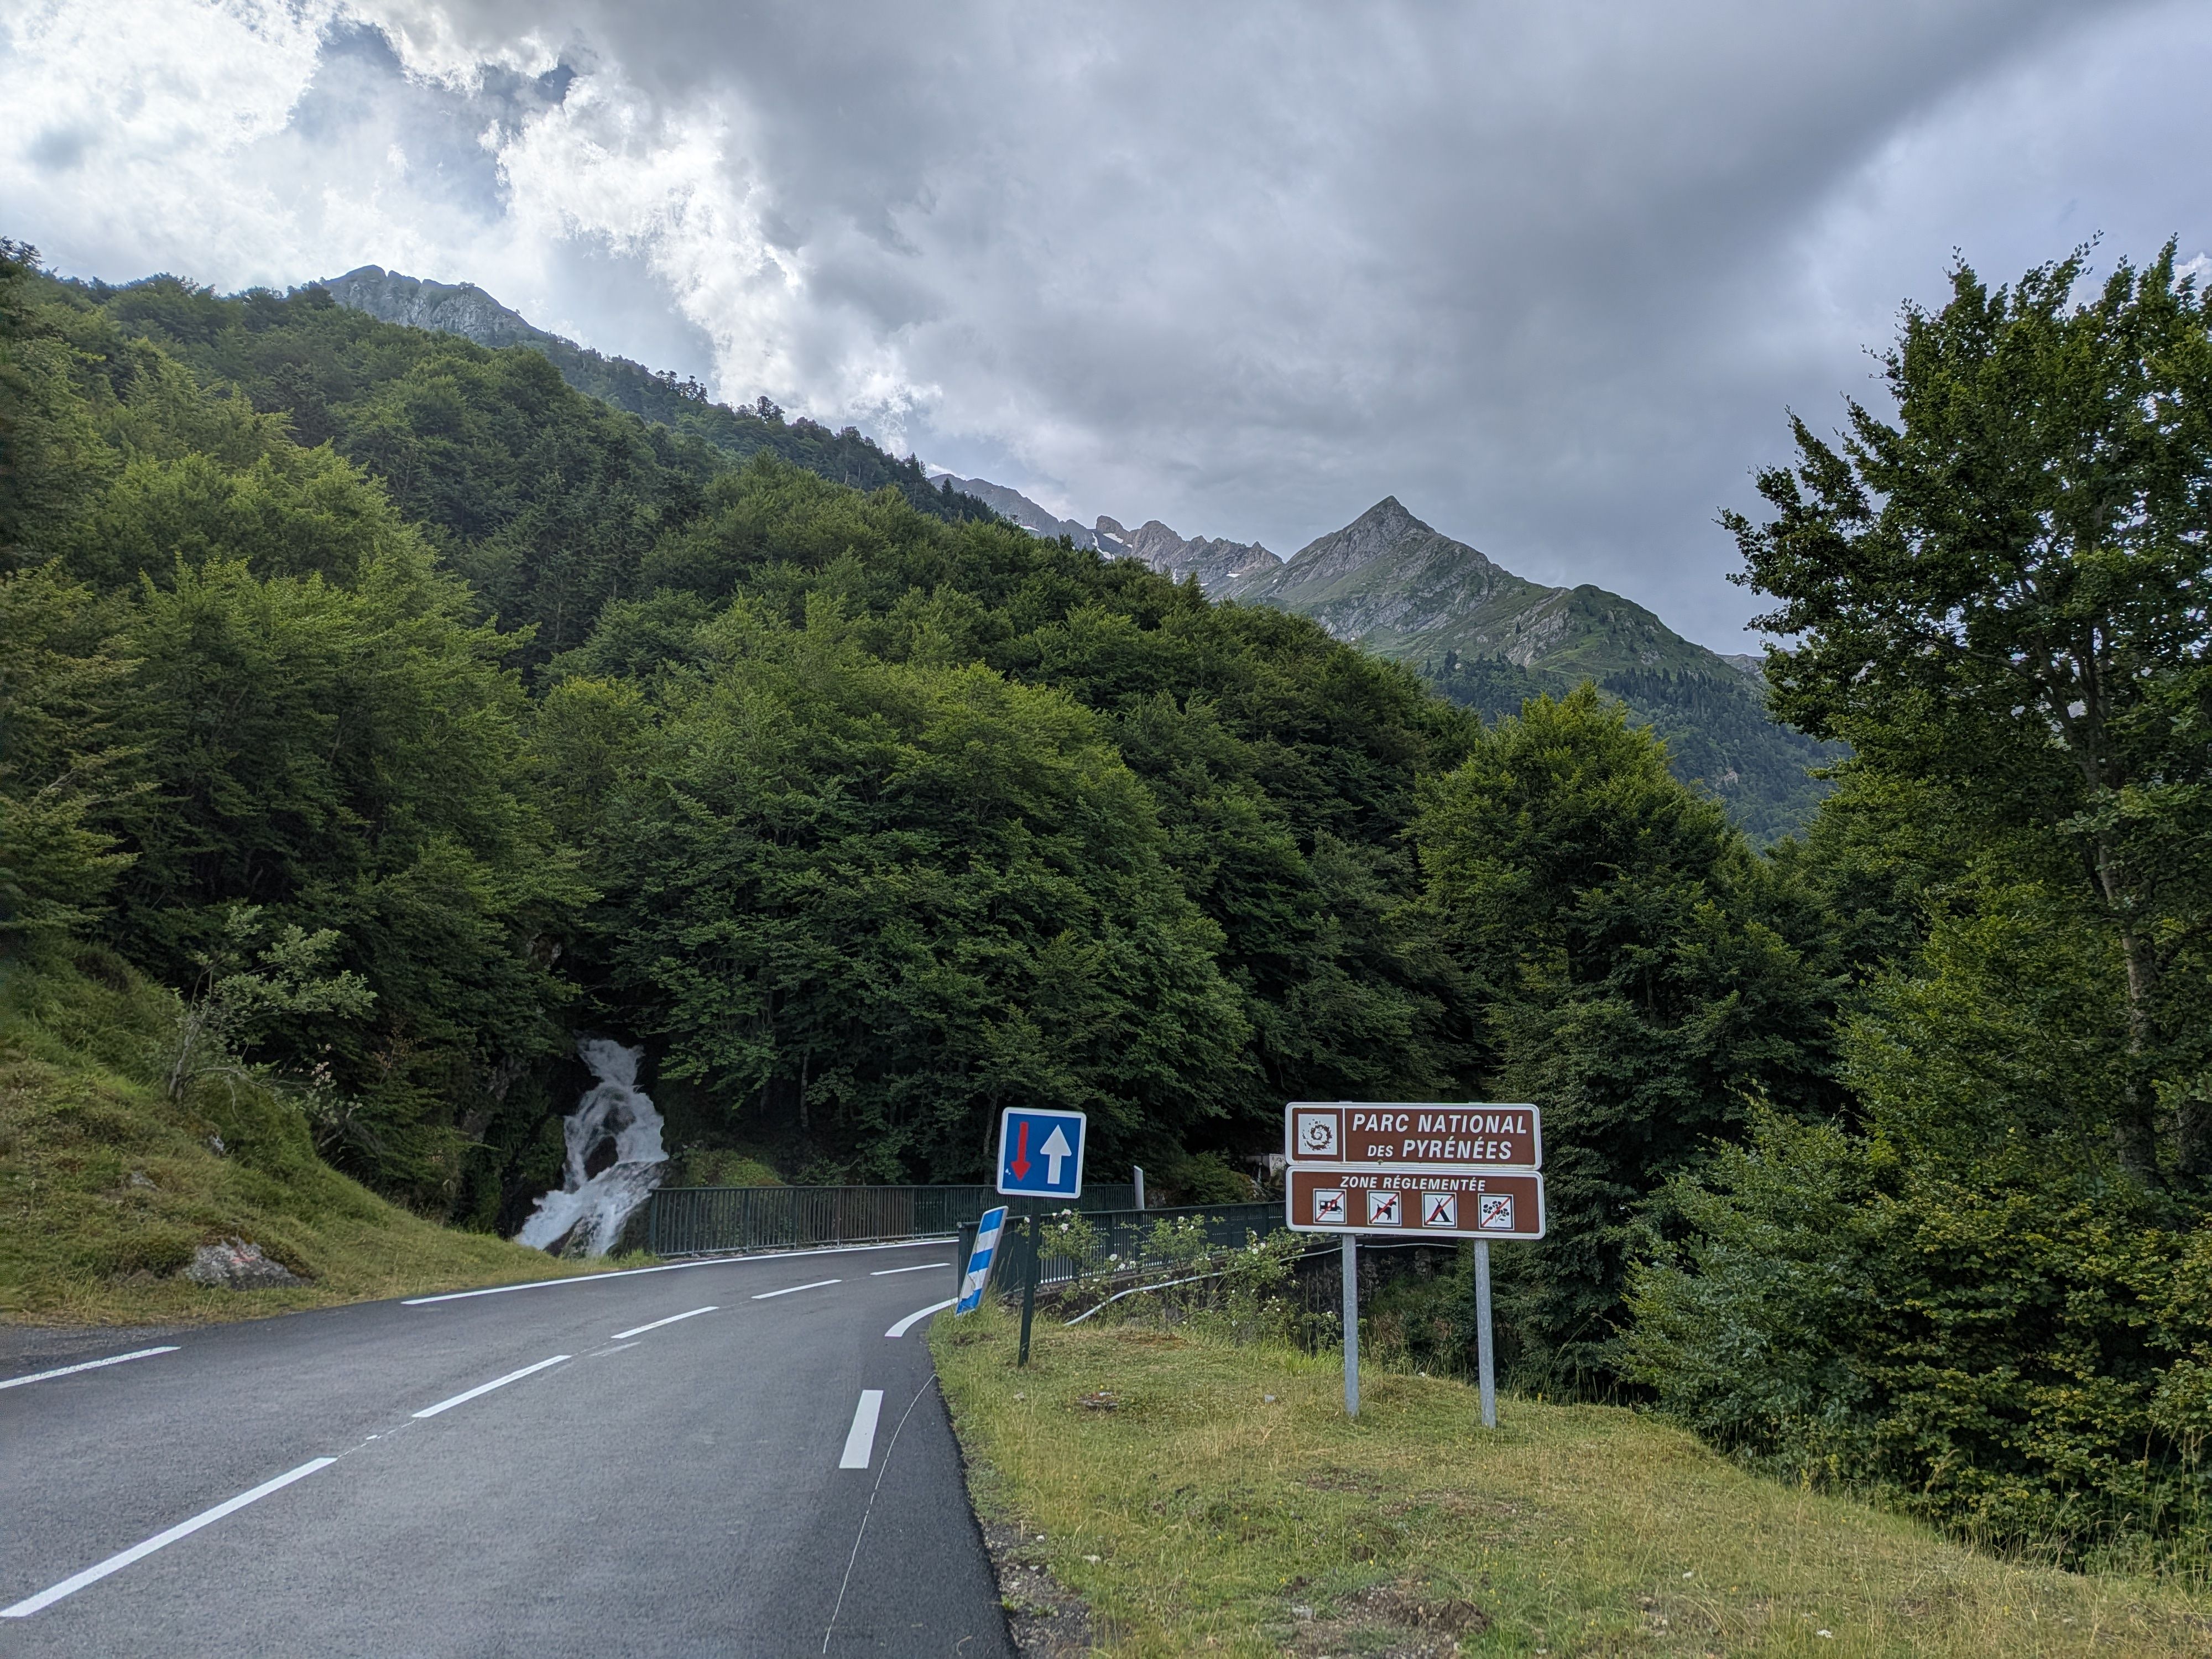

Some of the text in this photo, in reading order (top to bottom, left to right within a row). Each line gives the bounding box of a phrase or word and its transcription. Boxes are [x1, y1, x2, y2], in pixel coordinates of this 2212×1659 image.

[1353, 1114, 1527, 1134] PARC NATIONAL
[1368, 1136, 1511, 1160] DES PYRÉNÉES
[1340, 1175, 1486, 1192] ZONE RÉGLEMENTÉE
